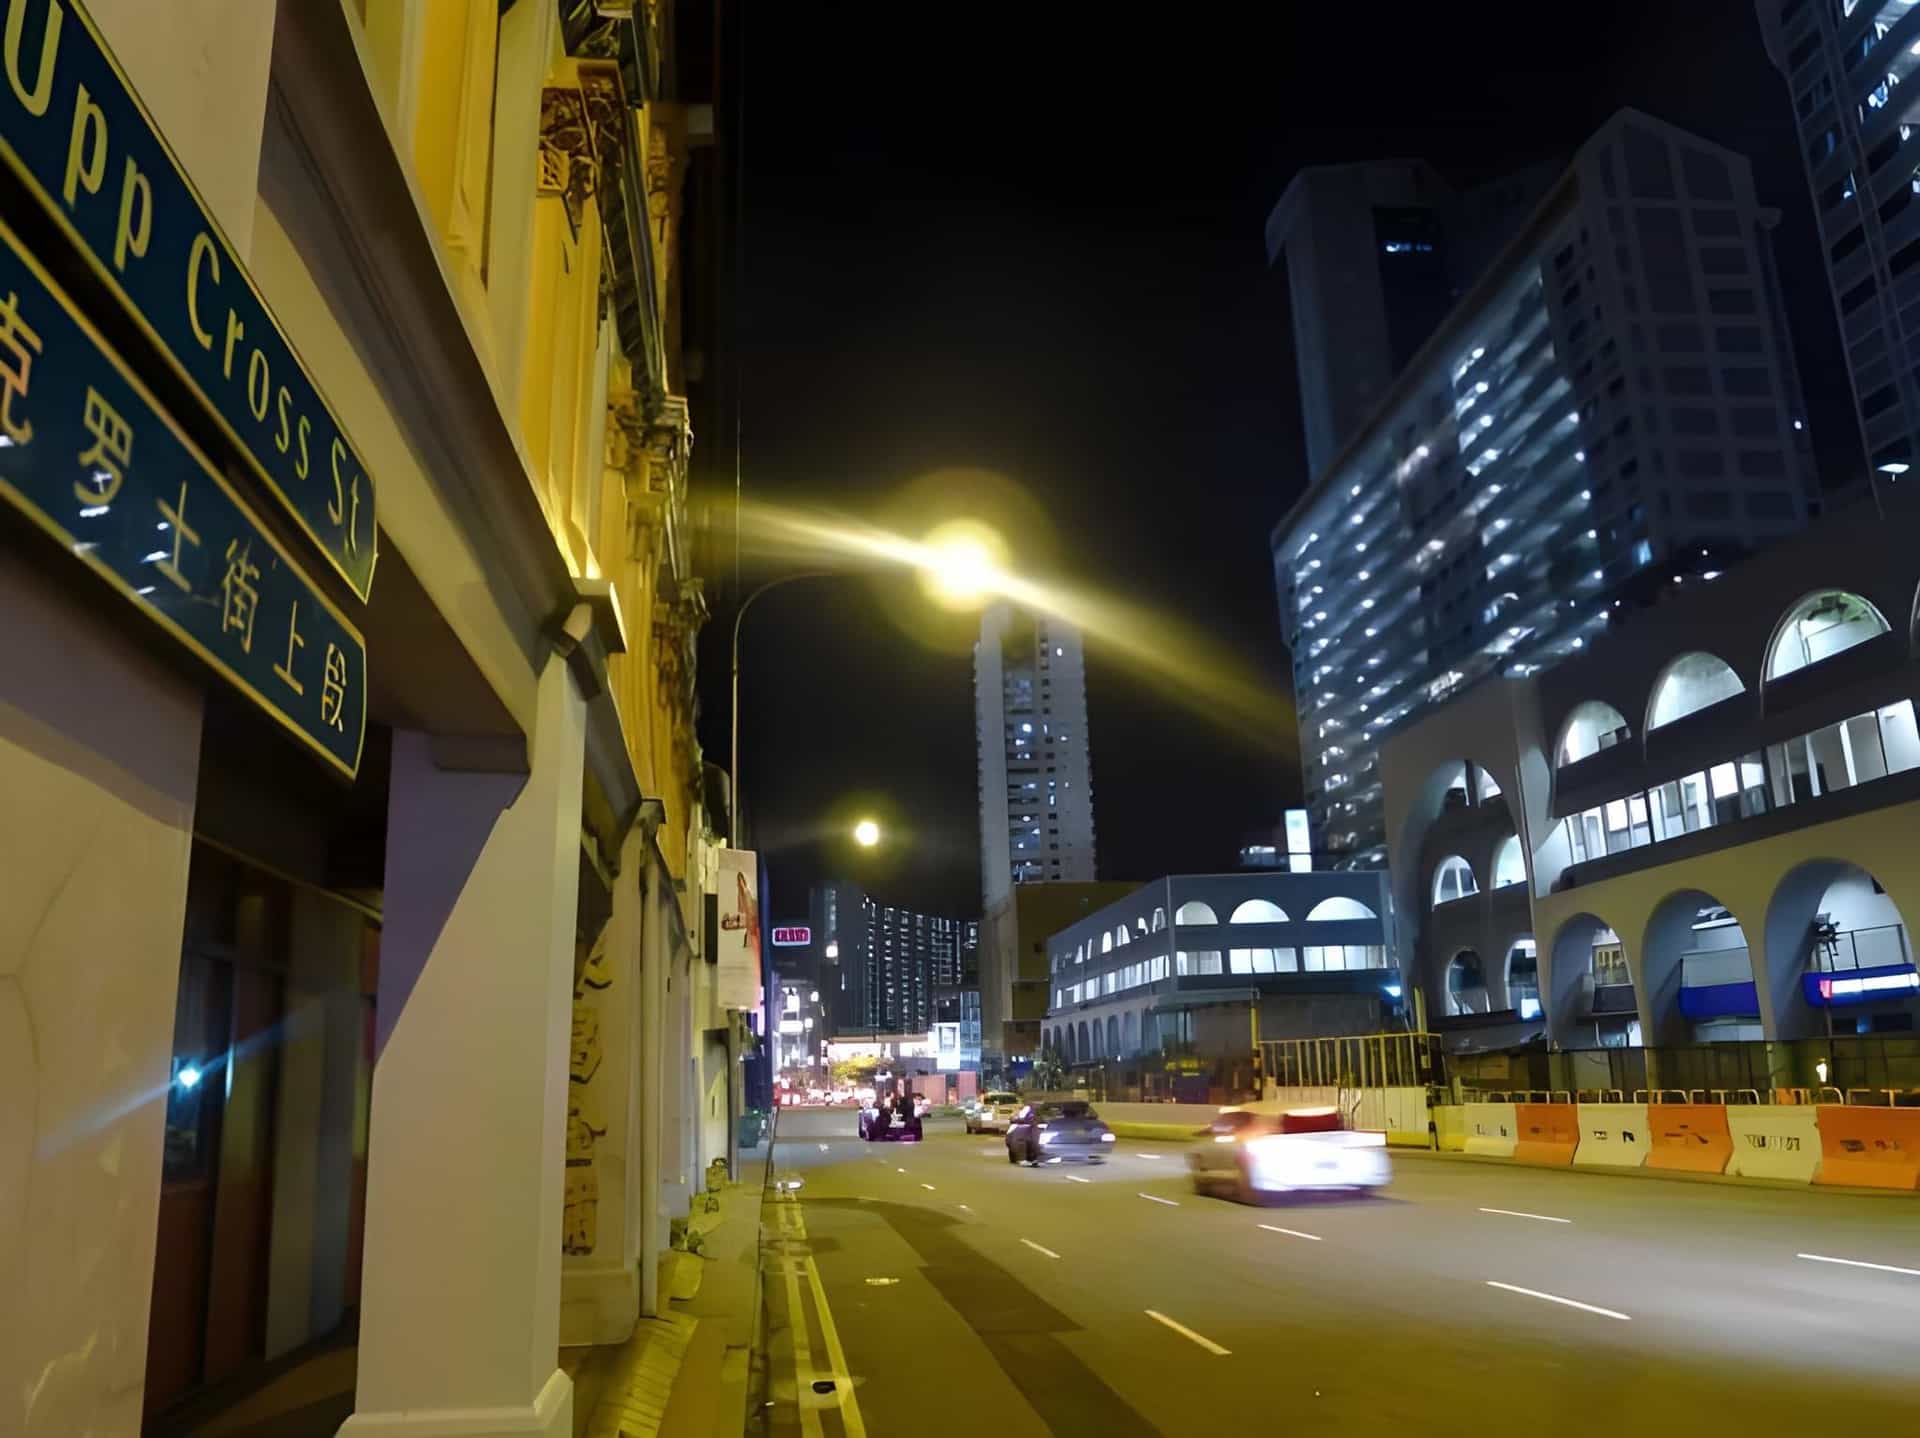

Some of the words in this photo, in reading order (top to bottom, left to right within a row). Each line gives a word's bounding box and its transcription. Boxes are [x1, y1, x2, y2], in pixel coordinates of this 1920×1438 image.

[2, 0, 153, 273] Upp
[187, 231, 312, 481] Cross
[327, 435, 361, 562] St
